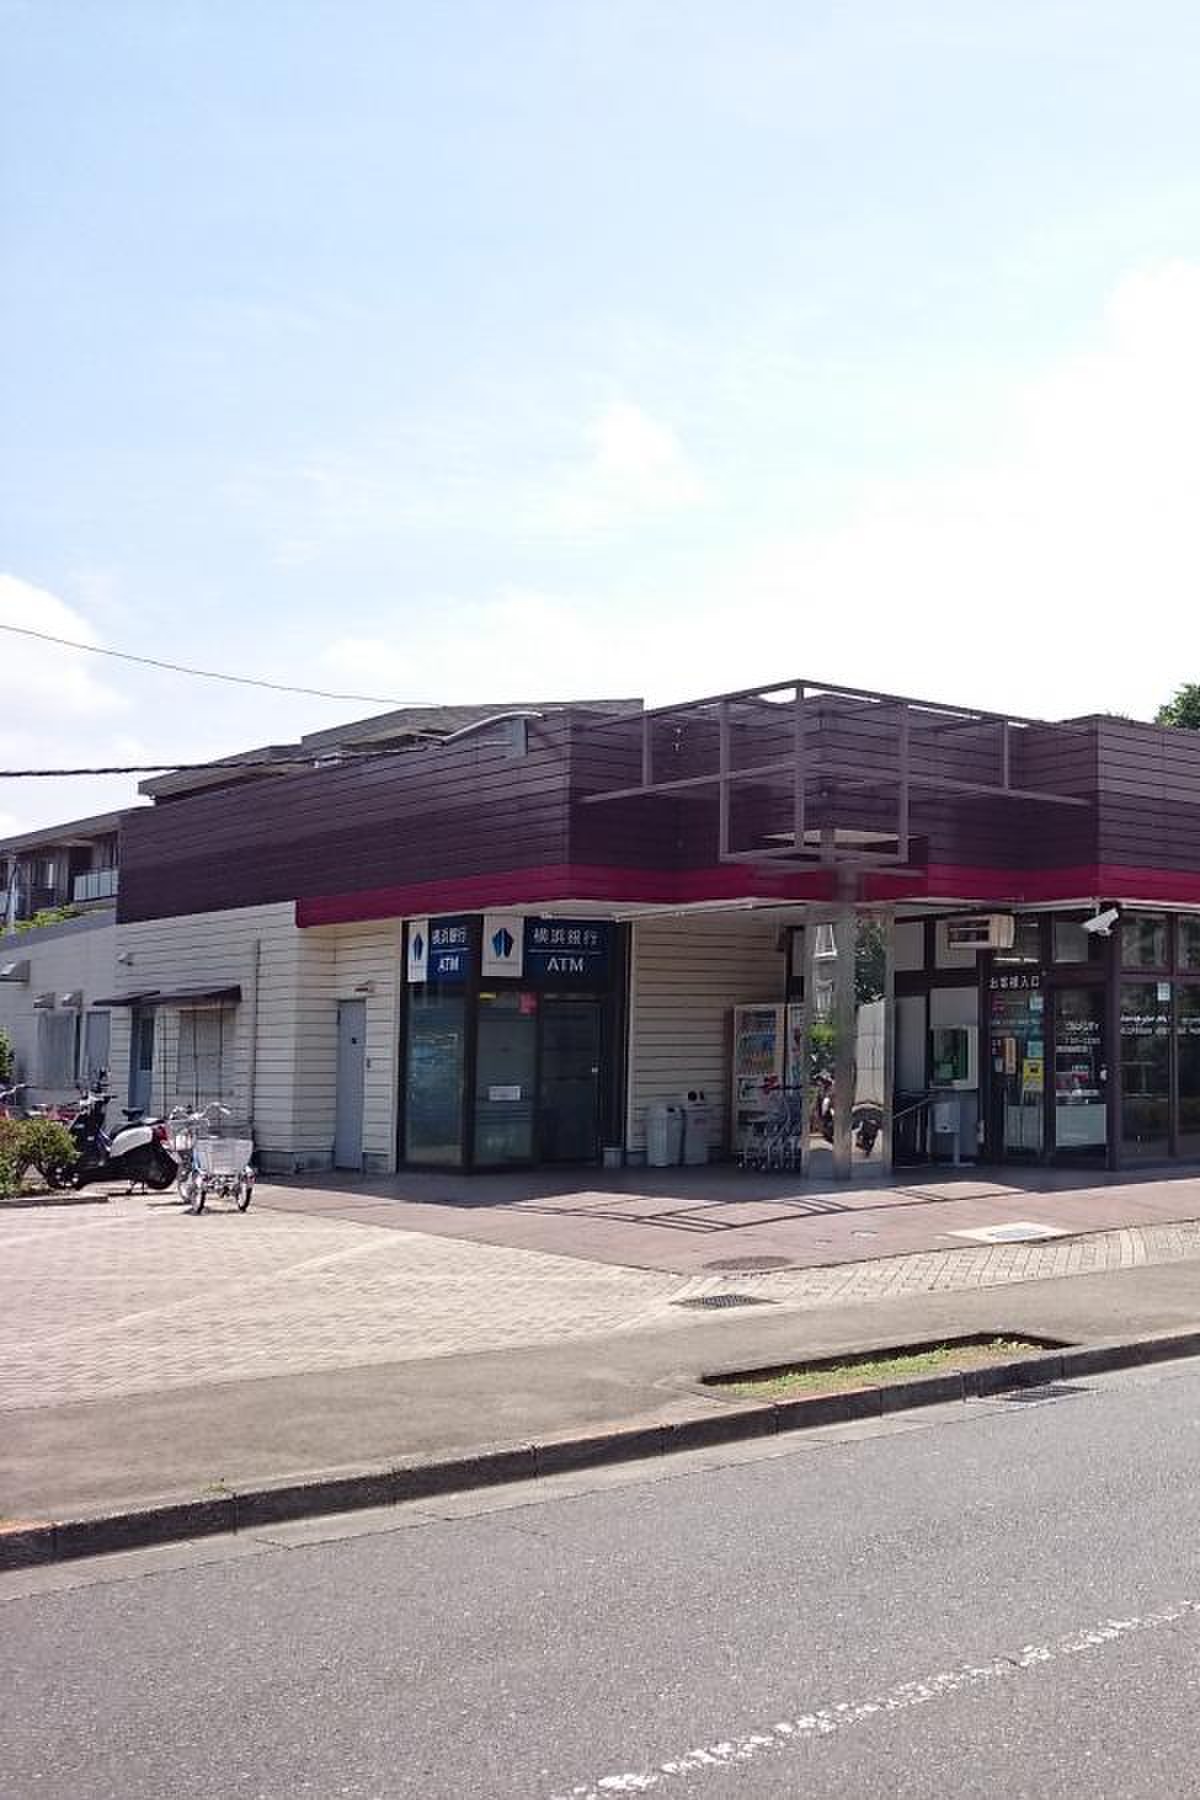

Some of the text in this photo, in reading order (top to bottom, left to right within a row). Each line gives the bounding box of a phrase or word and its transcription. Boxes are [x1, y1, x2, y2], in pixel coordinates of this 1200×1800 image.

[532, 926, 600, 945] 横浜銀行
[437, 956, 460, 972] ATM
[546, 956, 584, 972] ATM
